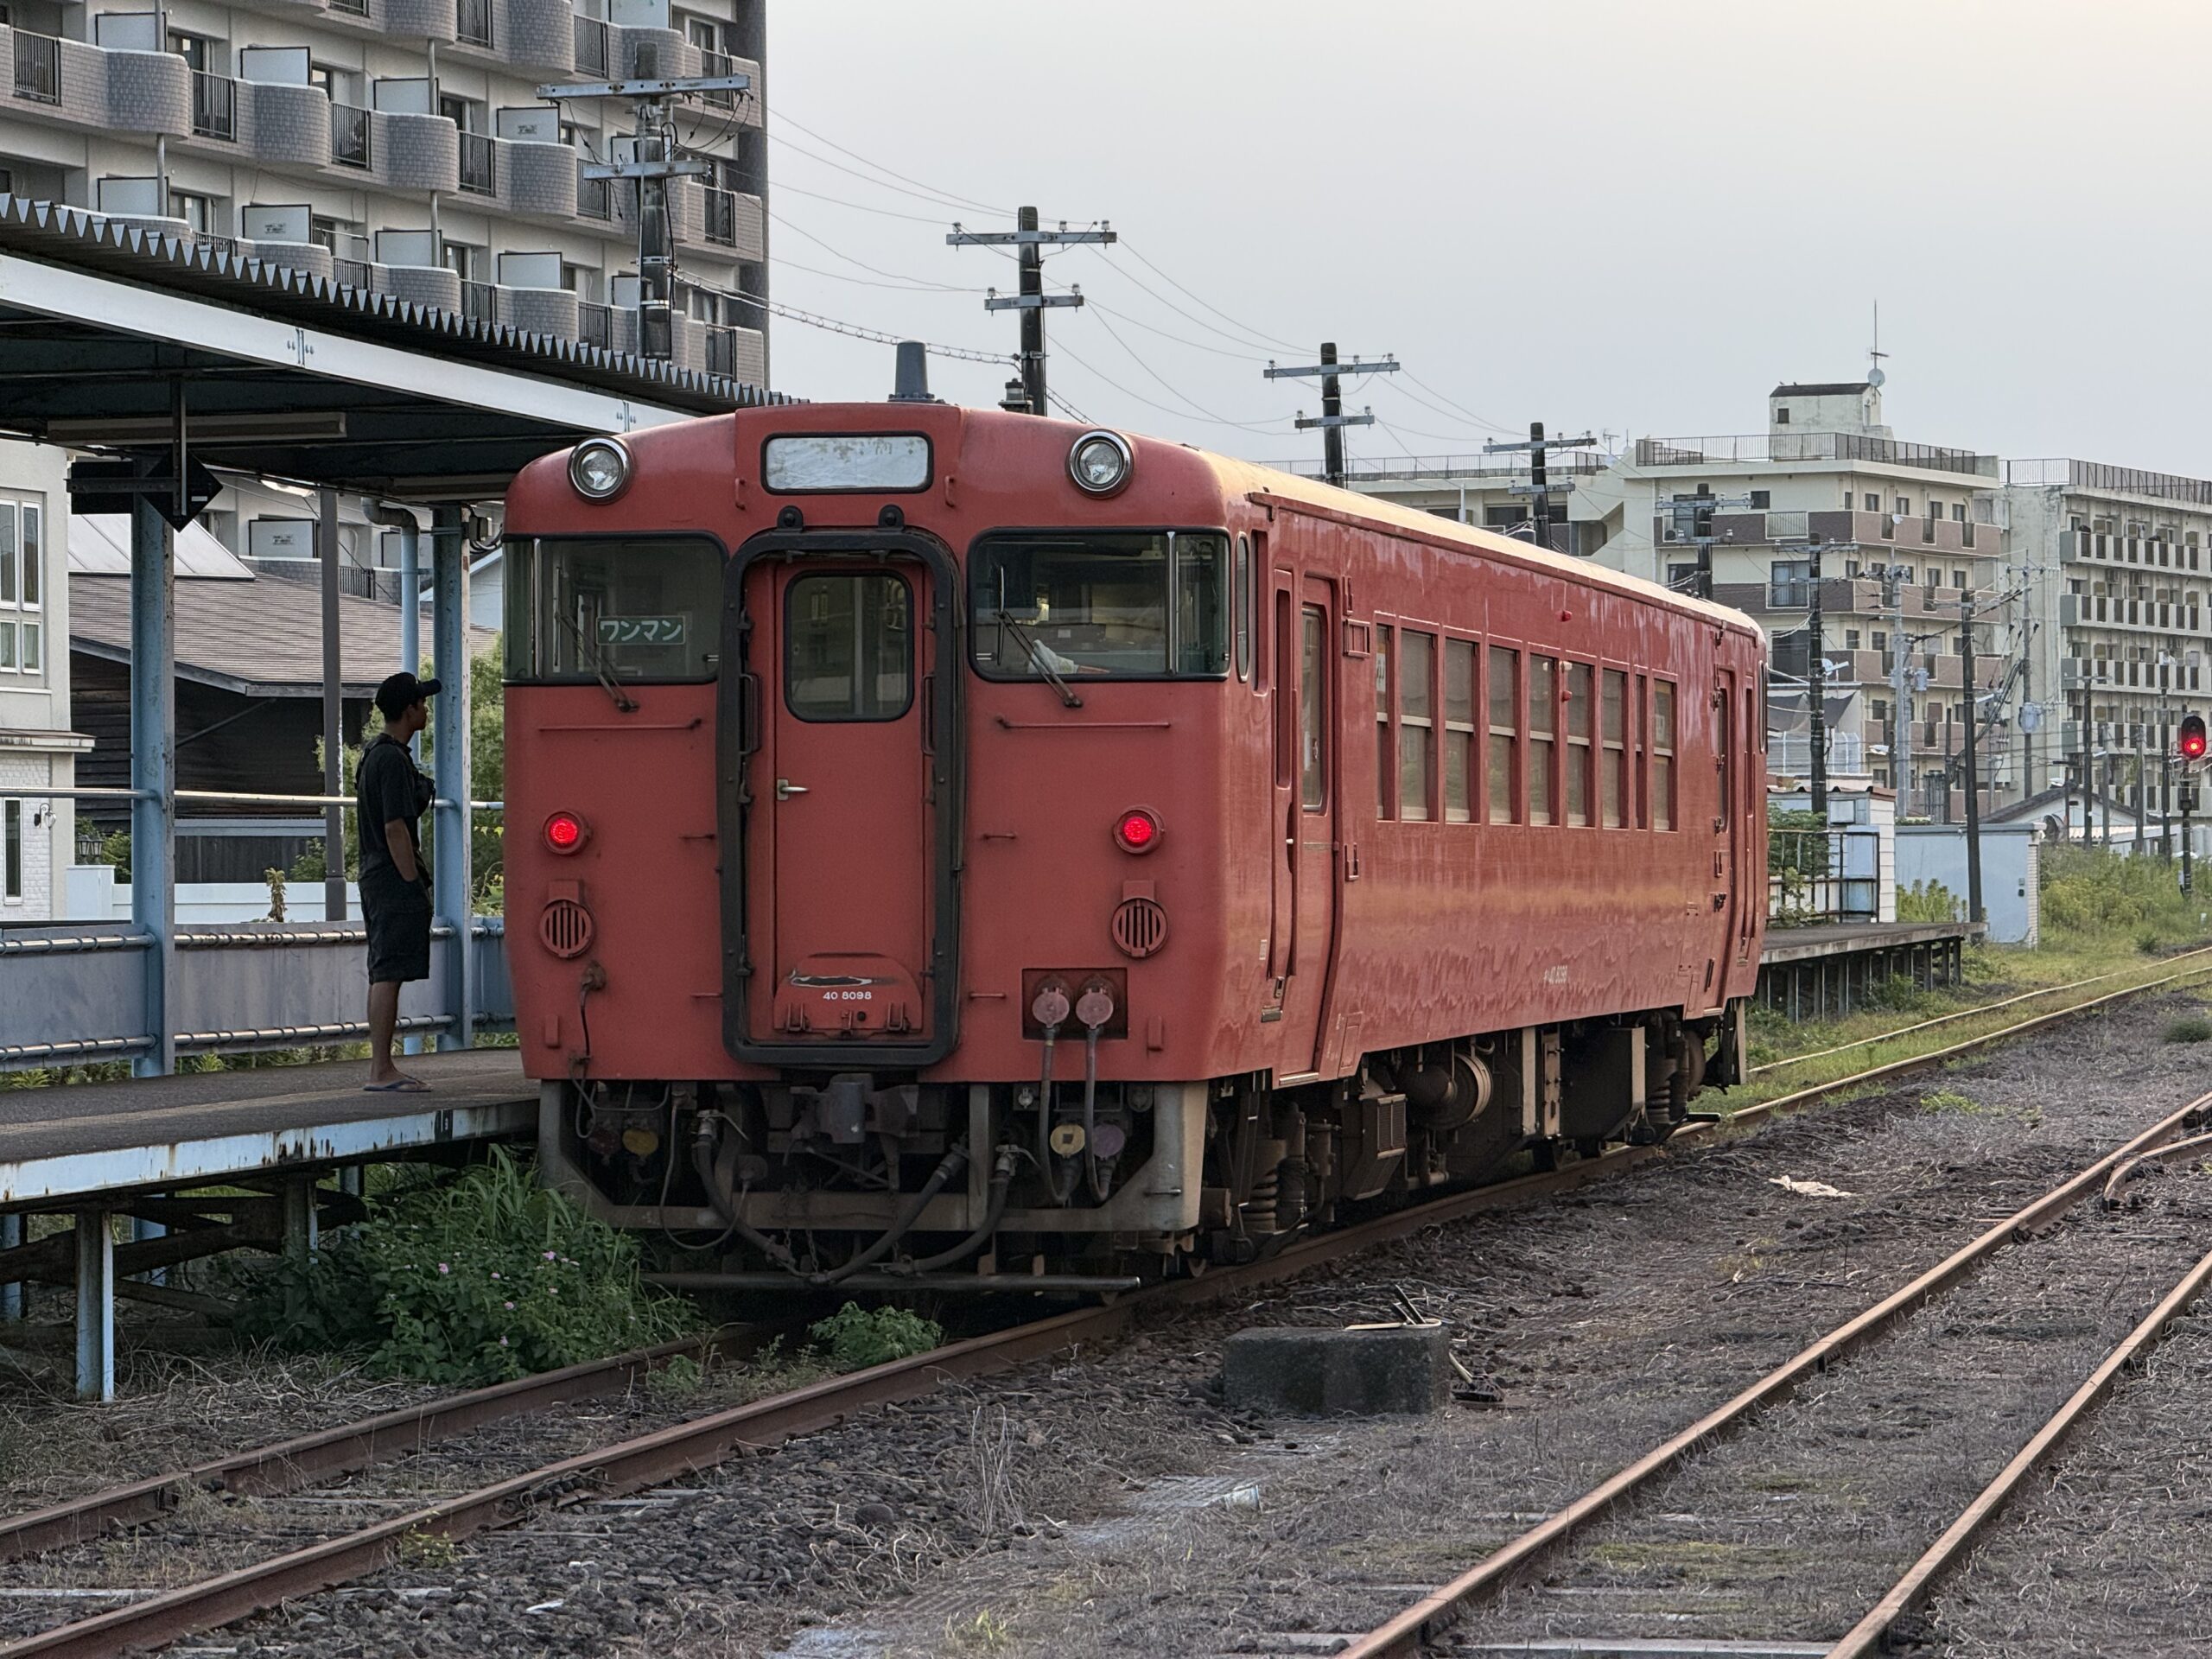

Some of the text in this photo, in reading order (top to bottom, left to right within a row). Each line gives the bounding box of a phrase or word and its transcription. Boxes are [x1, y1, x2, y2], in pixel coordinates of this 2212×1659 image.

[600, 620, 682, 641] ワンマン
[823, 991, 872, 1000] 40 8098
